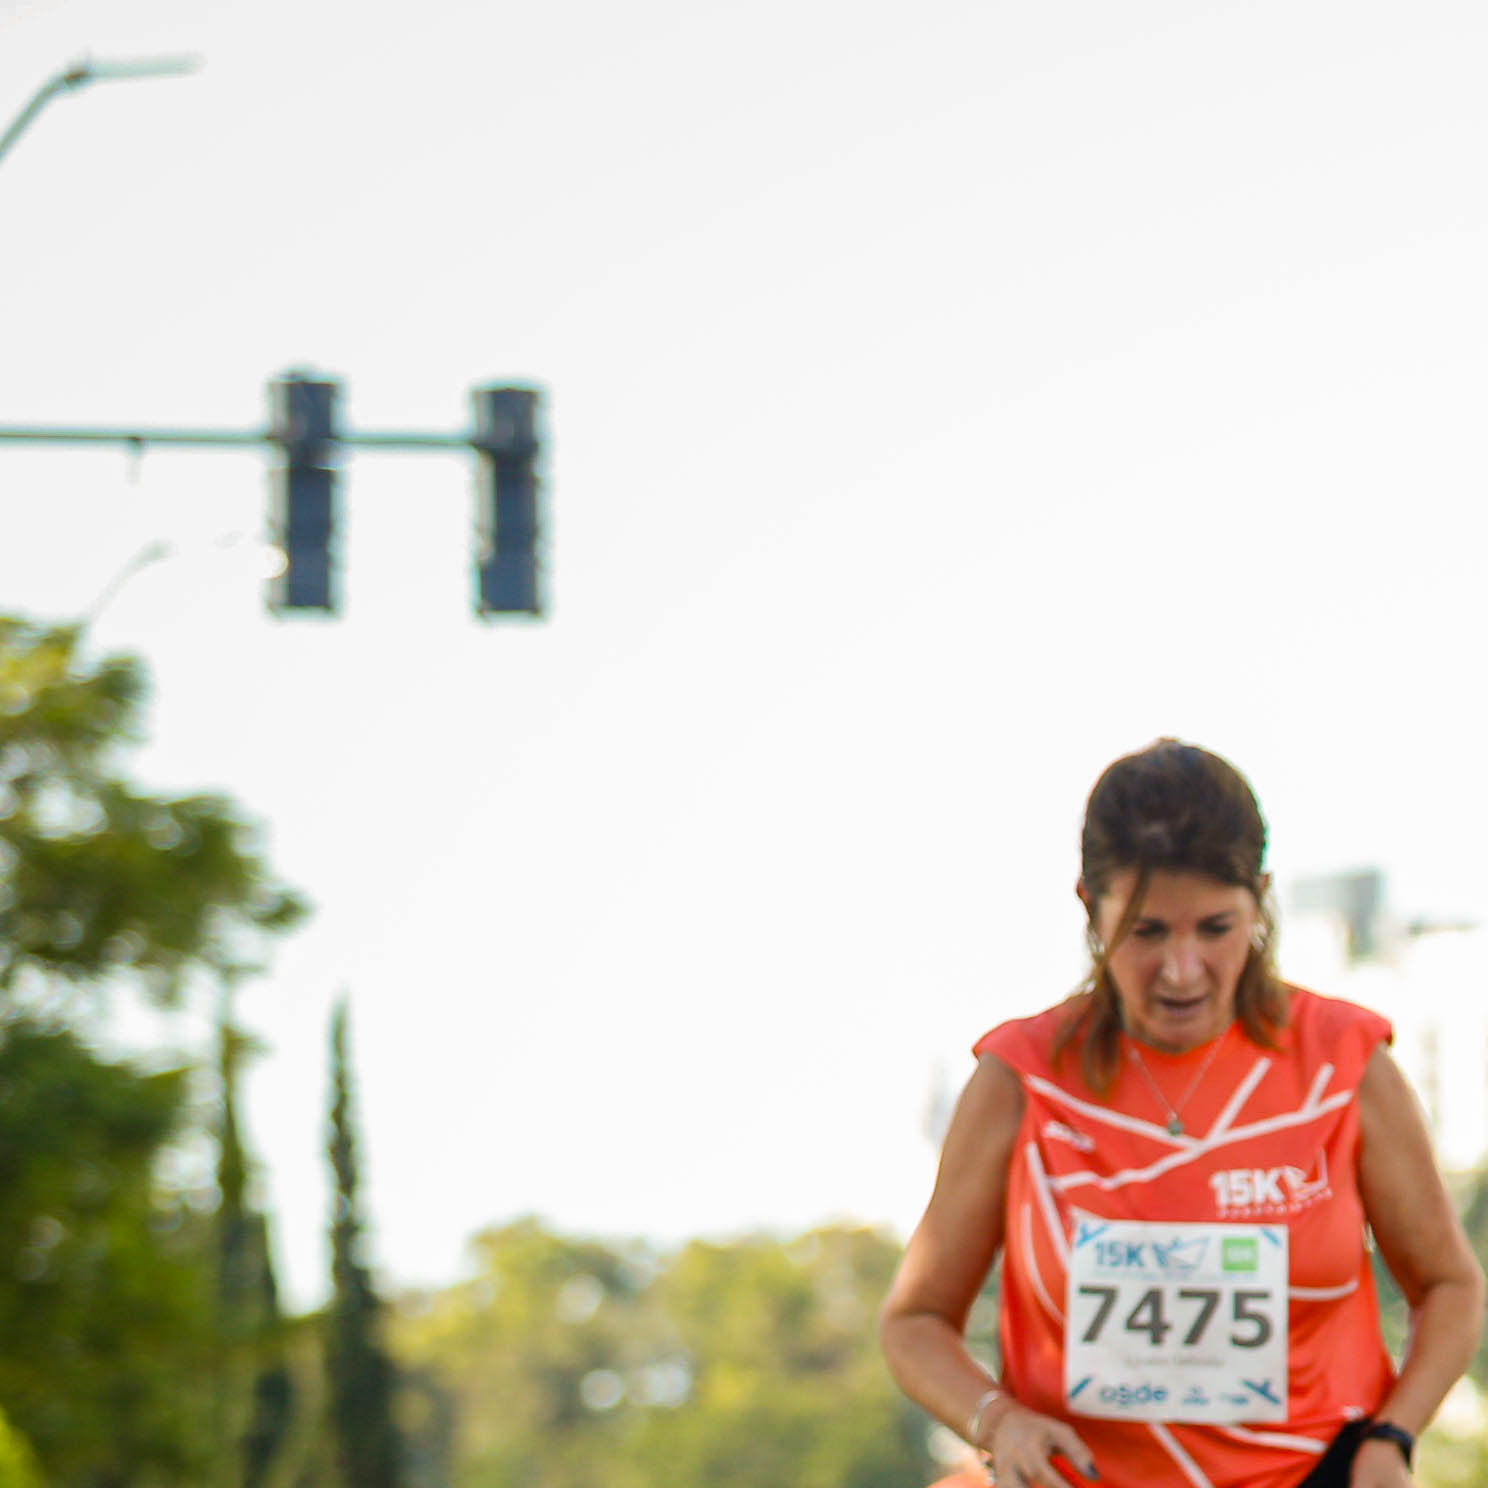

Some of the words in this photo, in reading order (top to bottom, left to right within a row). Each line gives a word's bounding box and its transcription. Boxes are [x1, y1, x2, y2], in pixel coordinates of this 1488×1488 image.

[1209, 1167, 1287, 1208] 15K
[1094, 1242, 1146, 1268] 15K
[1078, 1284, 1275, 1349] 7475
